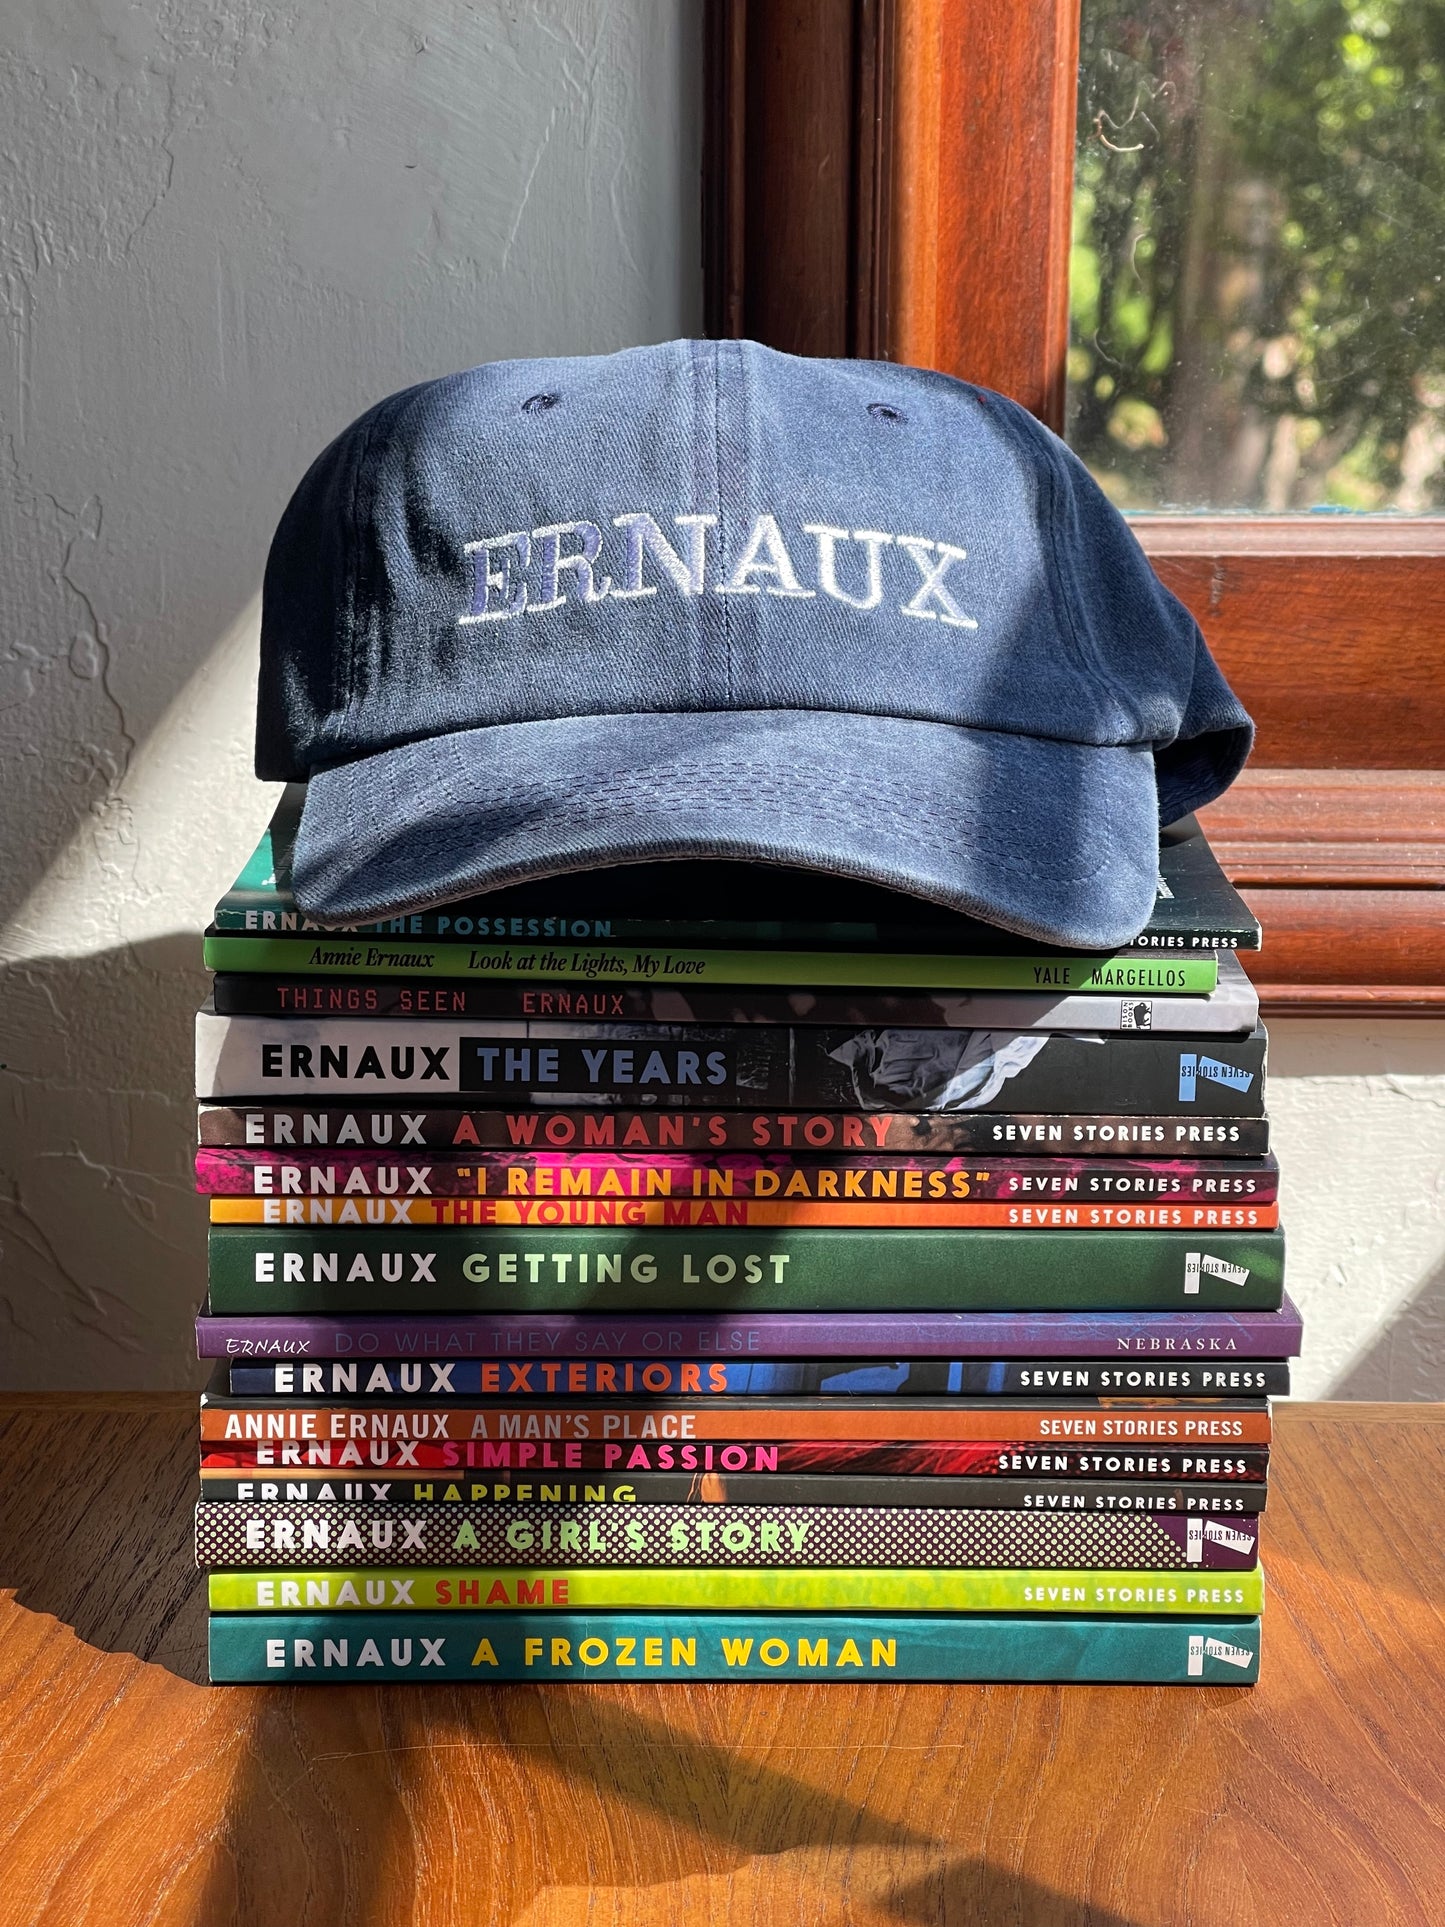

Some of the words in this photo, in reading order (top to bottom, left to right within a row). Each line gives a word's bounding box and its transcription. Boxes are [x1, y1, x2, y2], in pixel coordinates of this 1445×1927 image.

[458, 512, 978, 630] ERNAUX
[245, 910, 358, 933] ERNA
[438, 916, 611, 938] POSSESSION
[1129, 935, 1184, 947] TORIES
[1192, 937, 1238, 948] PRESS
[309, 948, 361, 967] Annie
[366, 948, 434, 968] Ernaux
[468, 950, 512, 971] Look
[517, 953, 535, 971] at
[540, 952, 567, 972] the
[570, 952, 628, 977] Lights,
[632, 954, 659, 978] My
[663, 954, 705, 975] Love
[1033, 966, 1071, 985] YALE
[1092, 967, 1187, 987] MARGELLOS
[277, 987, 377, 1010] THINGS
[400, 991, 465, 1011] SEEN
[523, 992, 624, 1015] ERNAUX
[261, 1044, 451, 1081] ERNAUX
[476, 1047, 559, 1082] THE
[582, 1048, 728, 1085] YEARS
[245, 1113, 427, 1144] ERNAUX
[452, 1115, 480, 1144] A
[506, 1115, 727, 1146] WOMAN'S
[752, 1116, 893, 1147] STORY
[993, 1124, 1062, 1141] SEVEN
[1074, 1124, 1165, 1142] STORIES
[1176, 1126, 1240, 1142] PRESS
[253, 1166, 432, 1194] ERNAUX
[457, 1167, 487, 1195] "I
[507, 1168, 672, 1196] REMAIN
[692, 1169, 734, 1196] IN
[754, 1170, 990, 1198] DARKNESS"
[1009, 1176, 1078, 1191] SEVEN
[1089, 1177, 1181, 1192] STORIES
[1192, 1178, 1256, 1193] PRESS
[263, 1199, 413, 1224] ERNAUX
[431, 1200, 496, 1224] THE
[516, 1200, 646, 1225] YOUNG
[664, 1201, 748, 1225] MAN
[1009, 1209, 1078, 1224] SEVEN
[1090, 1209, 1182, 1224] STORIES
[1193, 1210, 1258, 1225] PRESS
[255, 1252, 437, 1282] ERNAUX
[462, 1253, 657, 1283] GETTING
[683, 1254, 790, 1284] LOST
[225, 1338, 310, 1355] ERNAUX
[335, 1332, 380, 1353] DO
[395, 1332, 476, 1352] WHAT
[492, 1331, 561, 1352] THEY
[576, 1331, 628, 1352] SAY
[642, 1331, 682, 1352] OR
[698, 1331, 760, 1351] ELSE
[1117, 1337, 1237, 1350] NEBRASKA
[274, 1363, 456, 1393] ERNAUX
[481, 1363, 728, 1393] EXTERIORS
[1020, 1371, 1089, 1387] SEVEN
[1101, 1371, 1191, 1387] STORIES
[1203, 1372, 1266, 1388] PRESS
[225, 1414, 316, 1439] ANNIE
[331, 1414, 449, 1439] ERNAUX
[471, 1415, 487, 1439] A
[501, 1414, 589, 1439] MAN'S
[603, 1415, 696, 1439] PLACE
[1040, 1420, 1096, 1435] SEVEN
[1103, 1420, 1178, 1436] STORIES
[1185, 1421, 1243, 1436] PRESS
[256, 1440, 419, 1467] ERNAUX
[442, 1442, 582, 1468] SIMPLE
[605, 1444, 779, 1471] PASSION
[999, 1454, 1068, 1471] SEVEN
[1079, 1456, 1171, 1473] STORIES
[1183, 1458, 1247, 1474] PRESS
[237, 1483, 392, 1501] ERNAUX
[415, 1484, 636, 1502] HAPPENING
[1024, 1494, 1085, 1508] SEVEN
[1096, 1495, 1177, 1509] STORIES
[1187, 1497, 1244, 1511] PRESS
[245, 1520, 426, 1549] ERNAUX
[453, 1520, 480, 1549] A
[506, 1520, 643, 1551] GIRL'S
[670, 1521, 810, 1552] STORY
[257, 1580, 415, 1606] ERNAUX
[435, 1579, 569, 1605] SHAME
[1024, 1587, 1085, 1601] SEVEN
[1096, 1587, 1177, 1602] STORIES
[1187, 1588, 1244, 1603] PRESS
[266, 1639, 446, 1668] ERNAUX
[471, 1638, 498, 1667] A
[524, 1638, 696, 1667] FROZEN
[721, 1639, 896, 1667] WOMAN
